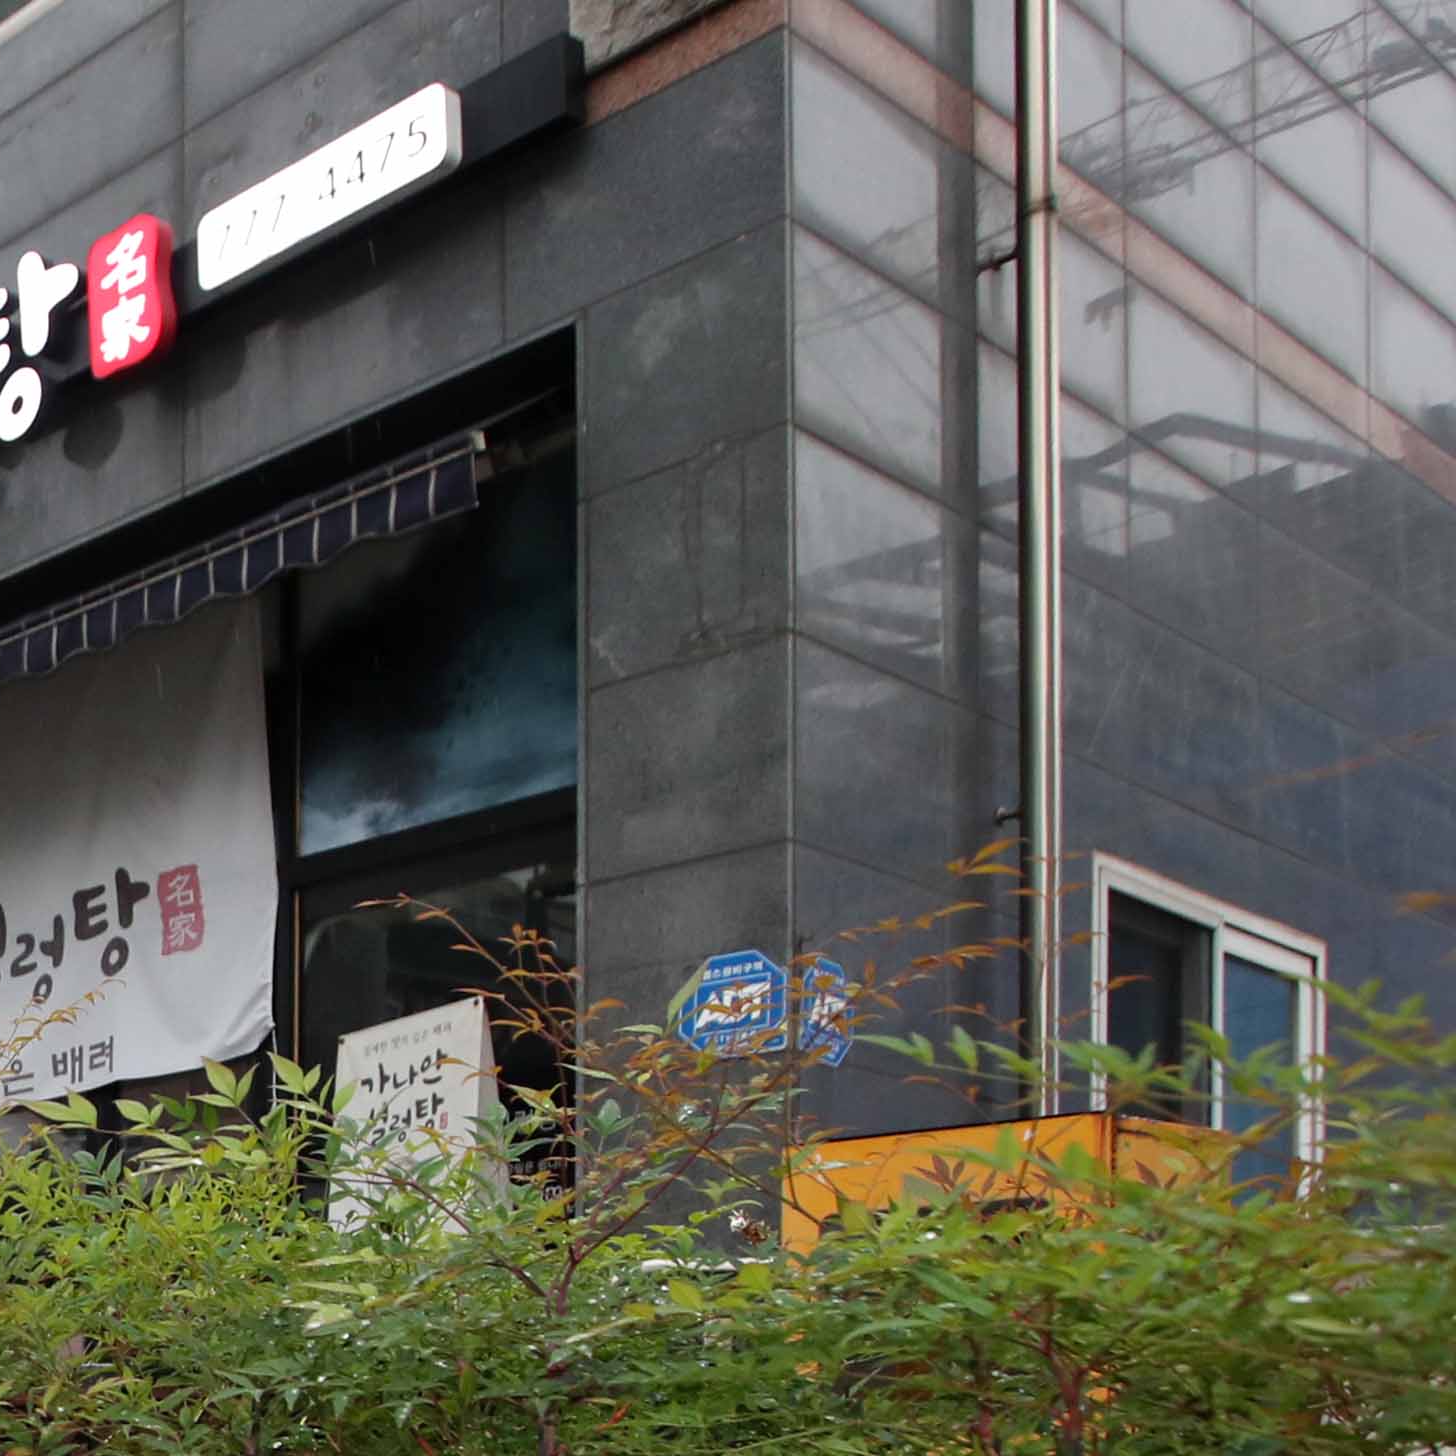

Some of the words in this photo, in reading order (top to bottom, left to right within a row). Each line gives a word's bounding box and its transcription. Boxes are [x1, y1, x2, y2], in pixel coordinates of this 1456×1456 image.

[99, 230, 151, 363] 名家
[166, 872, 201, 946] 名家
[51, 1034, 115, 1085] 배려
[361, 1047, 449, 1094] 가나안
